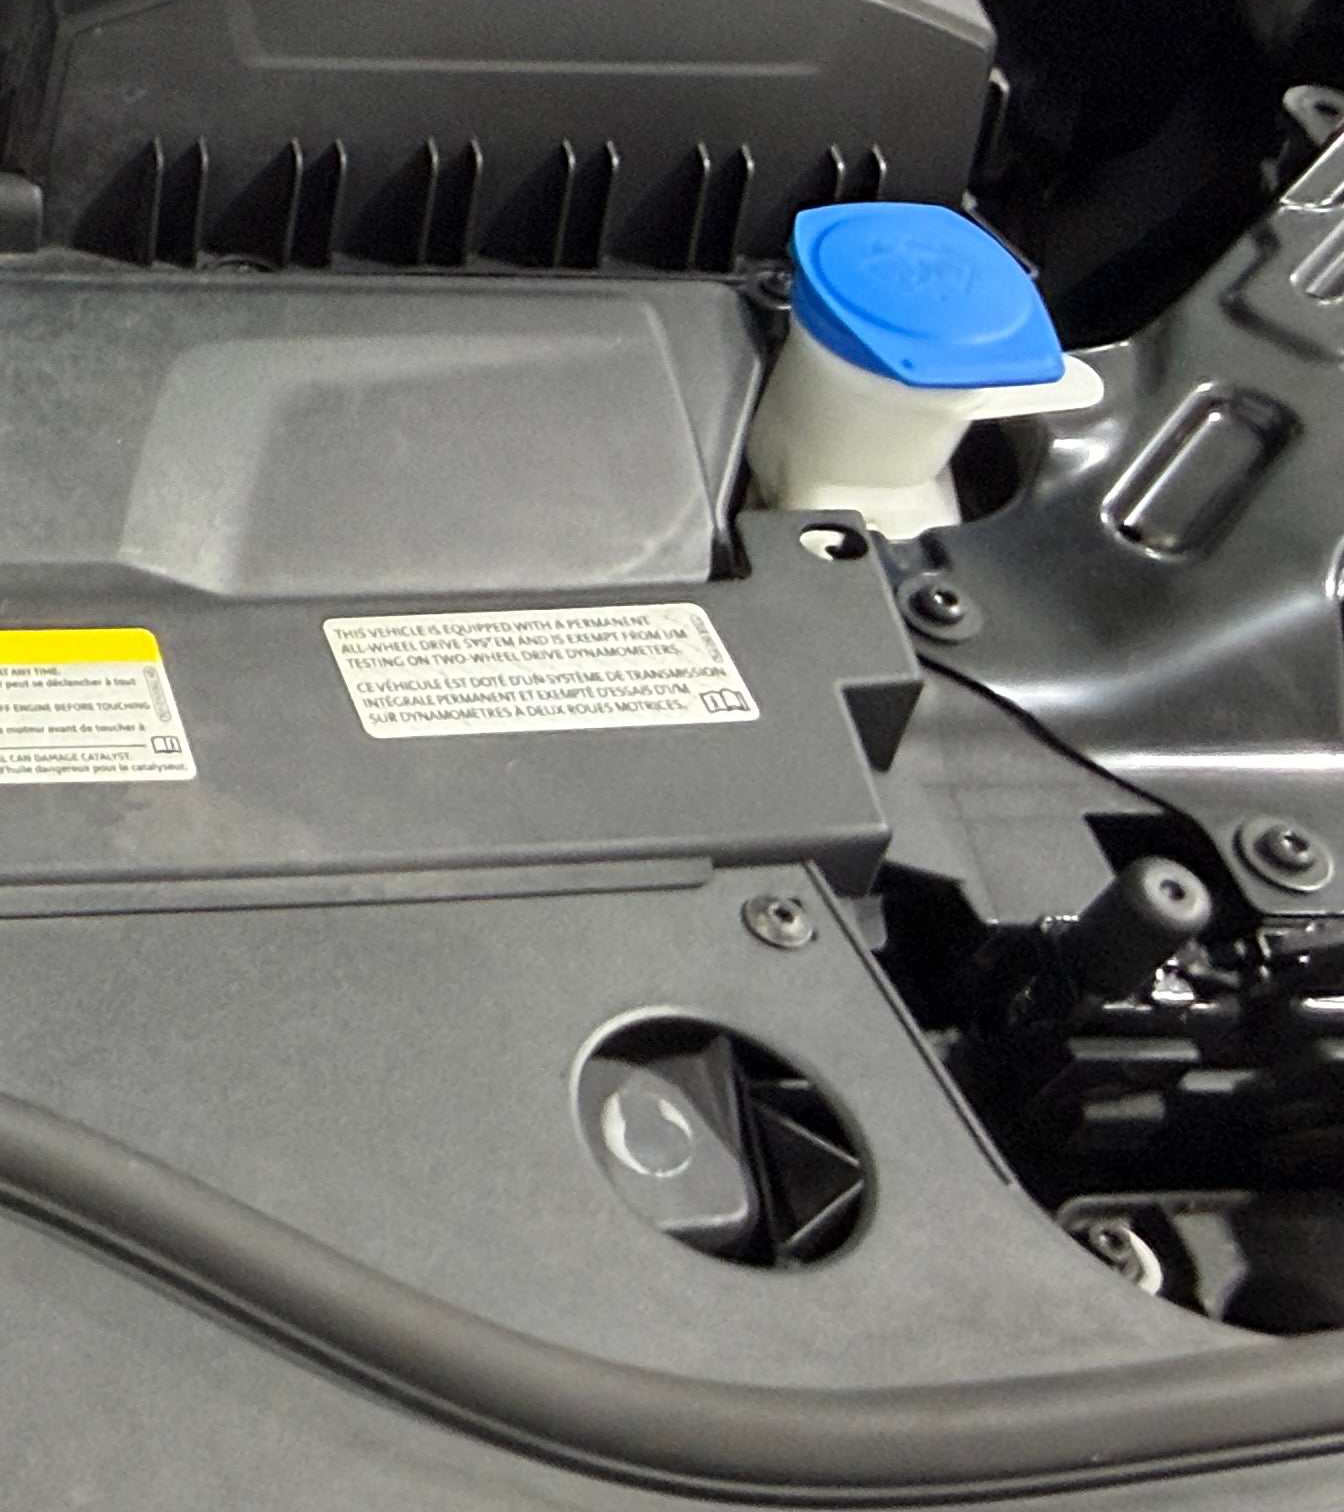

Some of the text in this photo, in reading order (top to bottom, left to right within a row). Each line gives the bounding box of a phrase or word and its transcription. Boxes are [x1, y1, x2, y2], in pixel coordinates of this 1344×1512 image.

[332, 627, 365, 639] THIS
[368, 625, 426, 638] VEHICLE
[427, 624, 441, 636] IS
[443, 623, 512, 636] EQUIPPED
[515, 620, 552, 633] WITH
[567, 615, 650, 629] PERMANENT
[341, 640, 418, 654] ALL-WHEEL
[420, 639, 461, 651] DRIVE
[464, 637, 516, 649] SYSTEM
[518, 635, 549, 646] AND
[567, 631, 618, 645] EXEMPT
[621, 630, 661, 641] FROM
[345, 656, 405, 669] TESTING
[407, 655, 430, 667] ON
[432, 652, 520, 666] TWO-WHEEL
[523, 649, 563, 661] DRIVE
[356, 681, 374, 693] CE
[375, 678, 442, 692] VÉHICULE
[443, 677, 467, 689] EST
[469, 674, 506, 687] DOTÉ
[508, 674, 545, 686] D'UN
[606, 669, 625, 682] DE
[627, 666, 727, 681] TRANSMISSION
[54, 702, 94, 712] BEFORE
[96, 701, 152, 711] TOUCHING
[436, 692, 517, 706] PERMANENT
[520, 690, 536, 702] ET
[368, 711, 398, 724] SUR
[527, 703, 563, 717] DEUX
[566, 701, 613, 715] ROUES
[34, 753, 78, 762] DAMAGE
